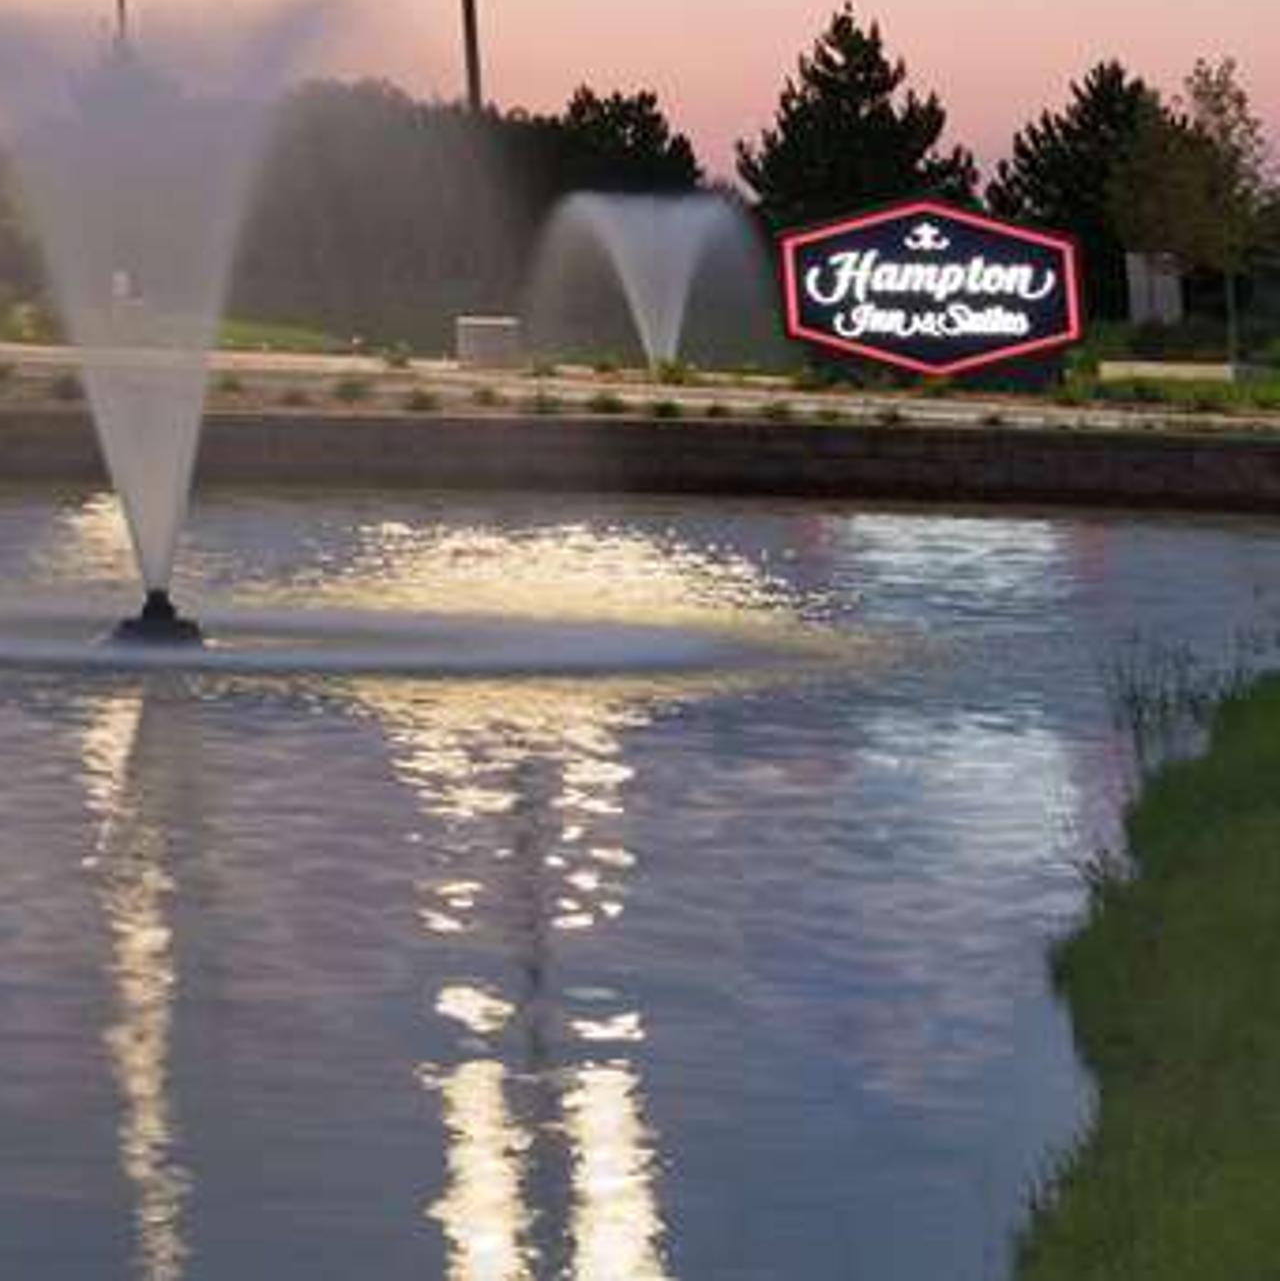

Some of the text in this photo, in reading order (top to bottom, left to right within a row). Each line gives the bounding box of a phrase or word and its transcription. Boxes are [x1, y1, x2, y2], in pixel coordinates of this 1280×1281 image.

[806, 249, 1056, 303] Hampton
[834, 303, 922, 337] Inn
[940, 303, 1030, 335] Suites
